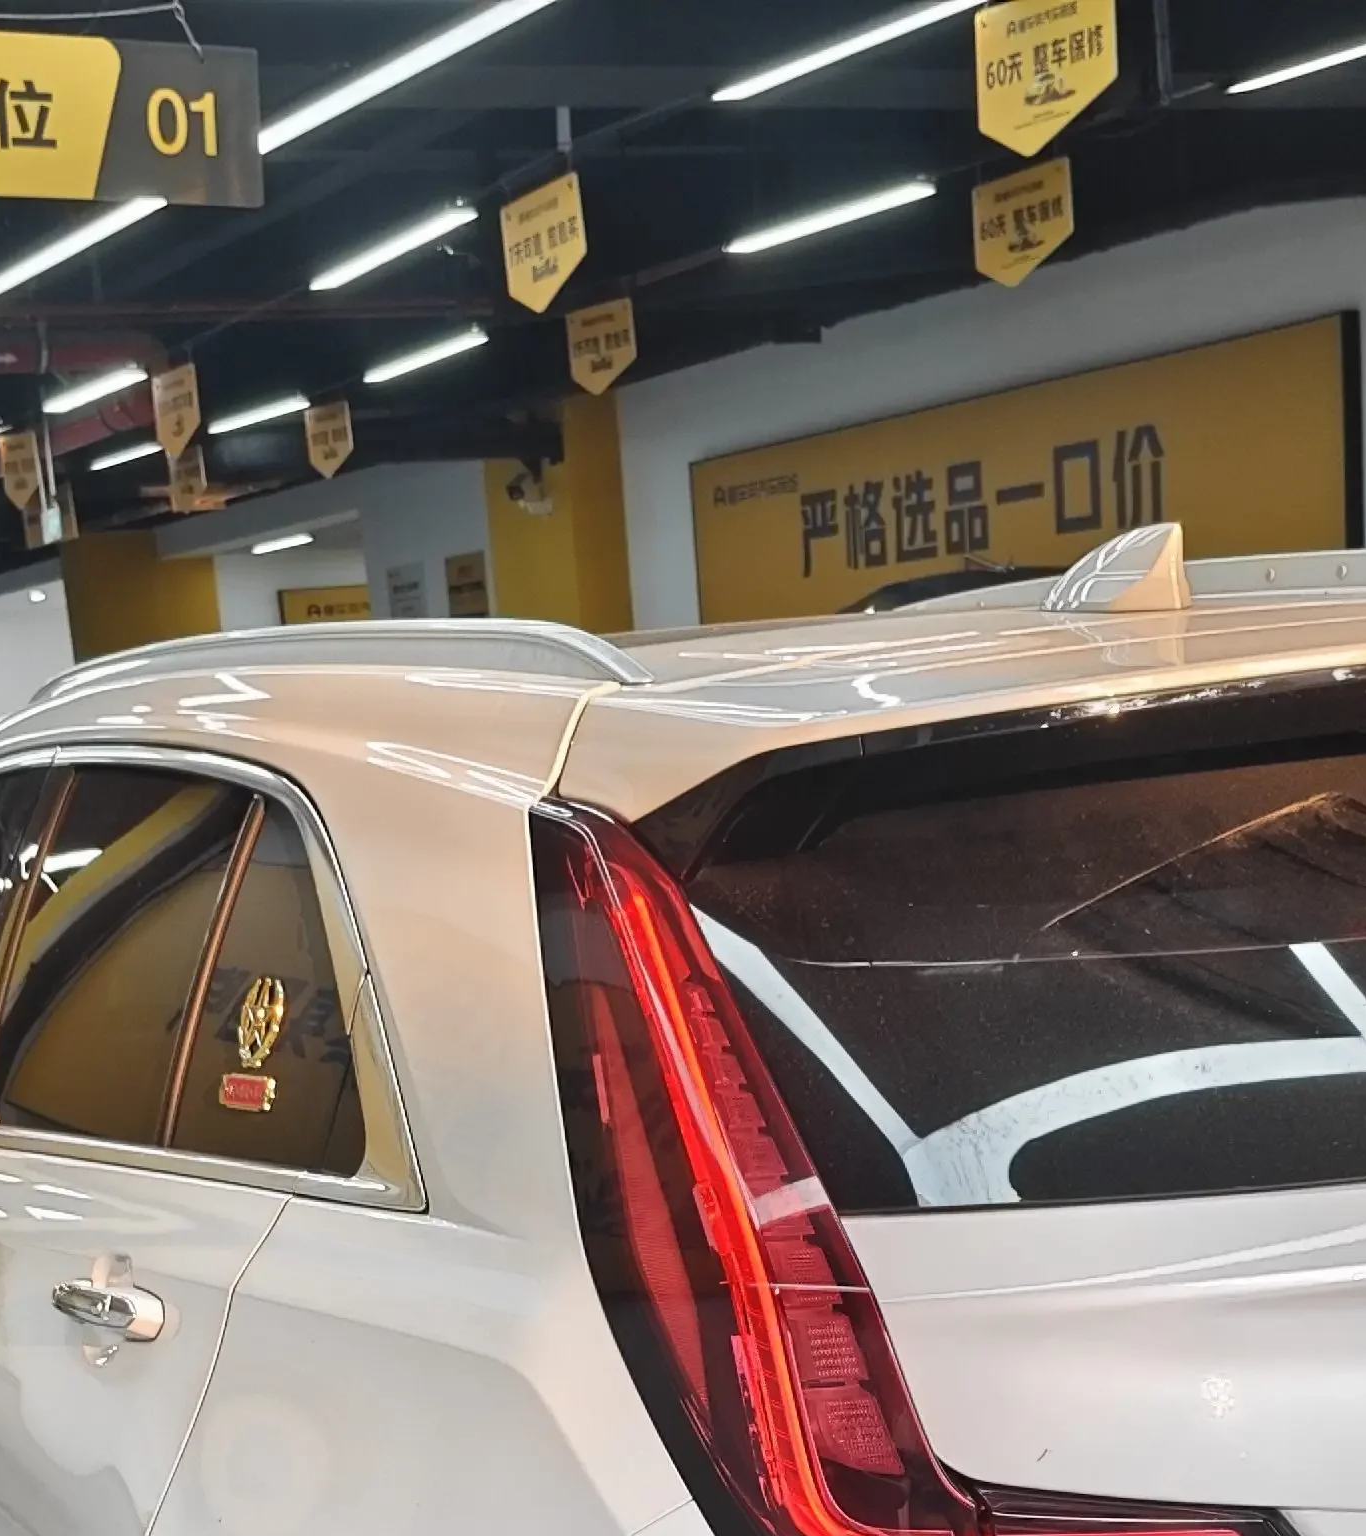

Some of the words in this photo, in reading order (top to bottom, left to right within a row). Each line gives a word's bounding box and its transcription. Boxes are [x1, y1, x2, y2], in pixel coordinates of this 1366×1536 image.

[986, 52, 1023, 90] 60天
[1033, 24, 1104, 76] 整车保修
[146, 88, 218, 157] 01
[800, 424, 1165, 578] 严格选品一口价
